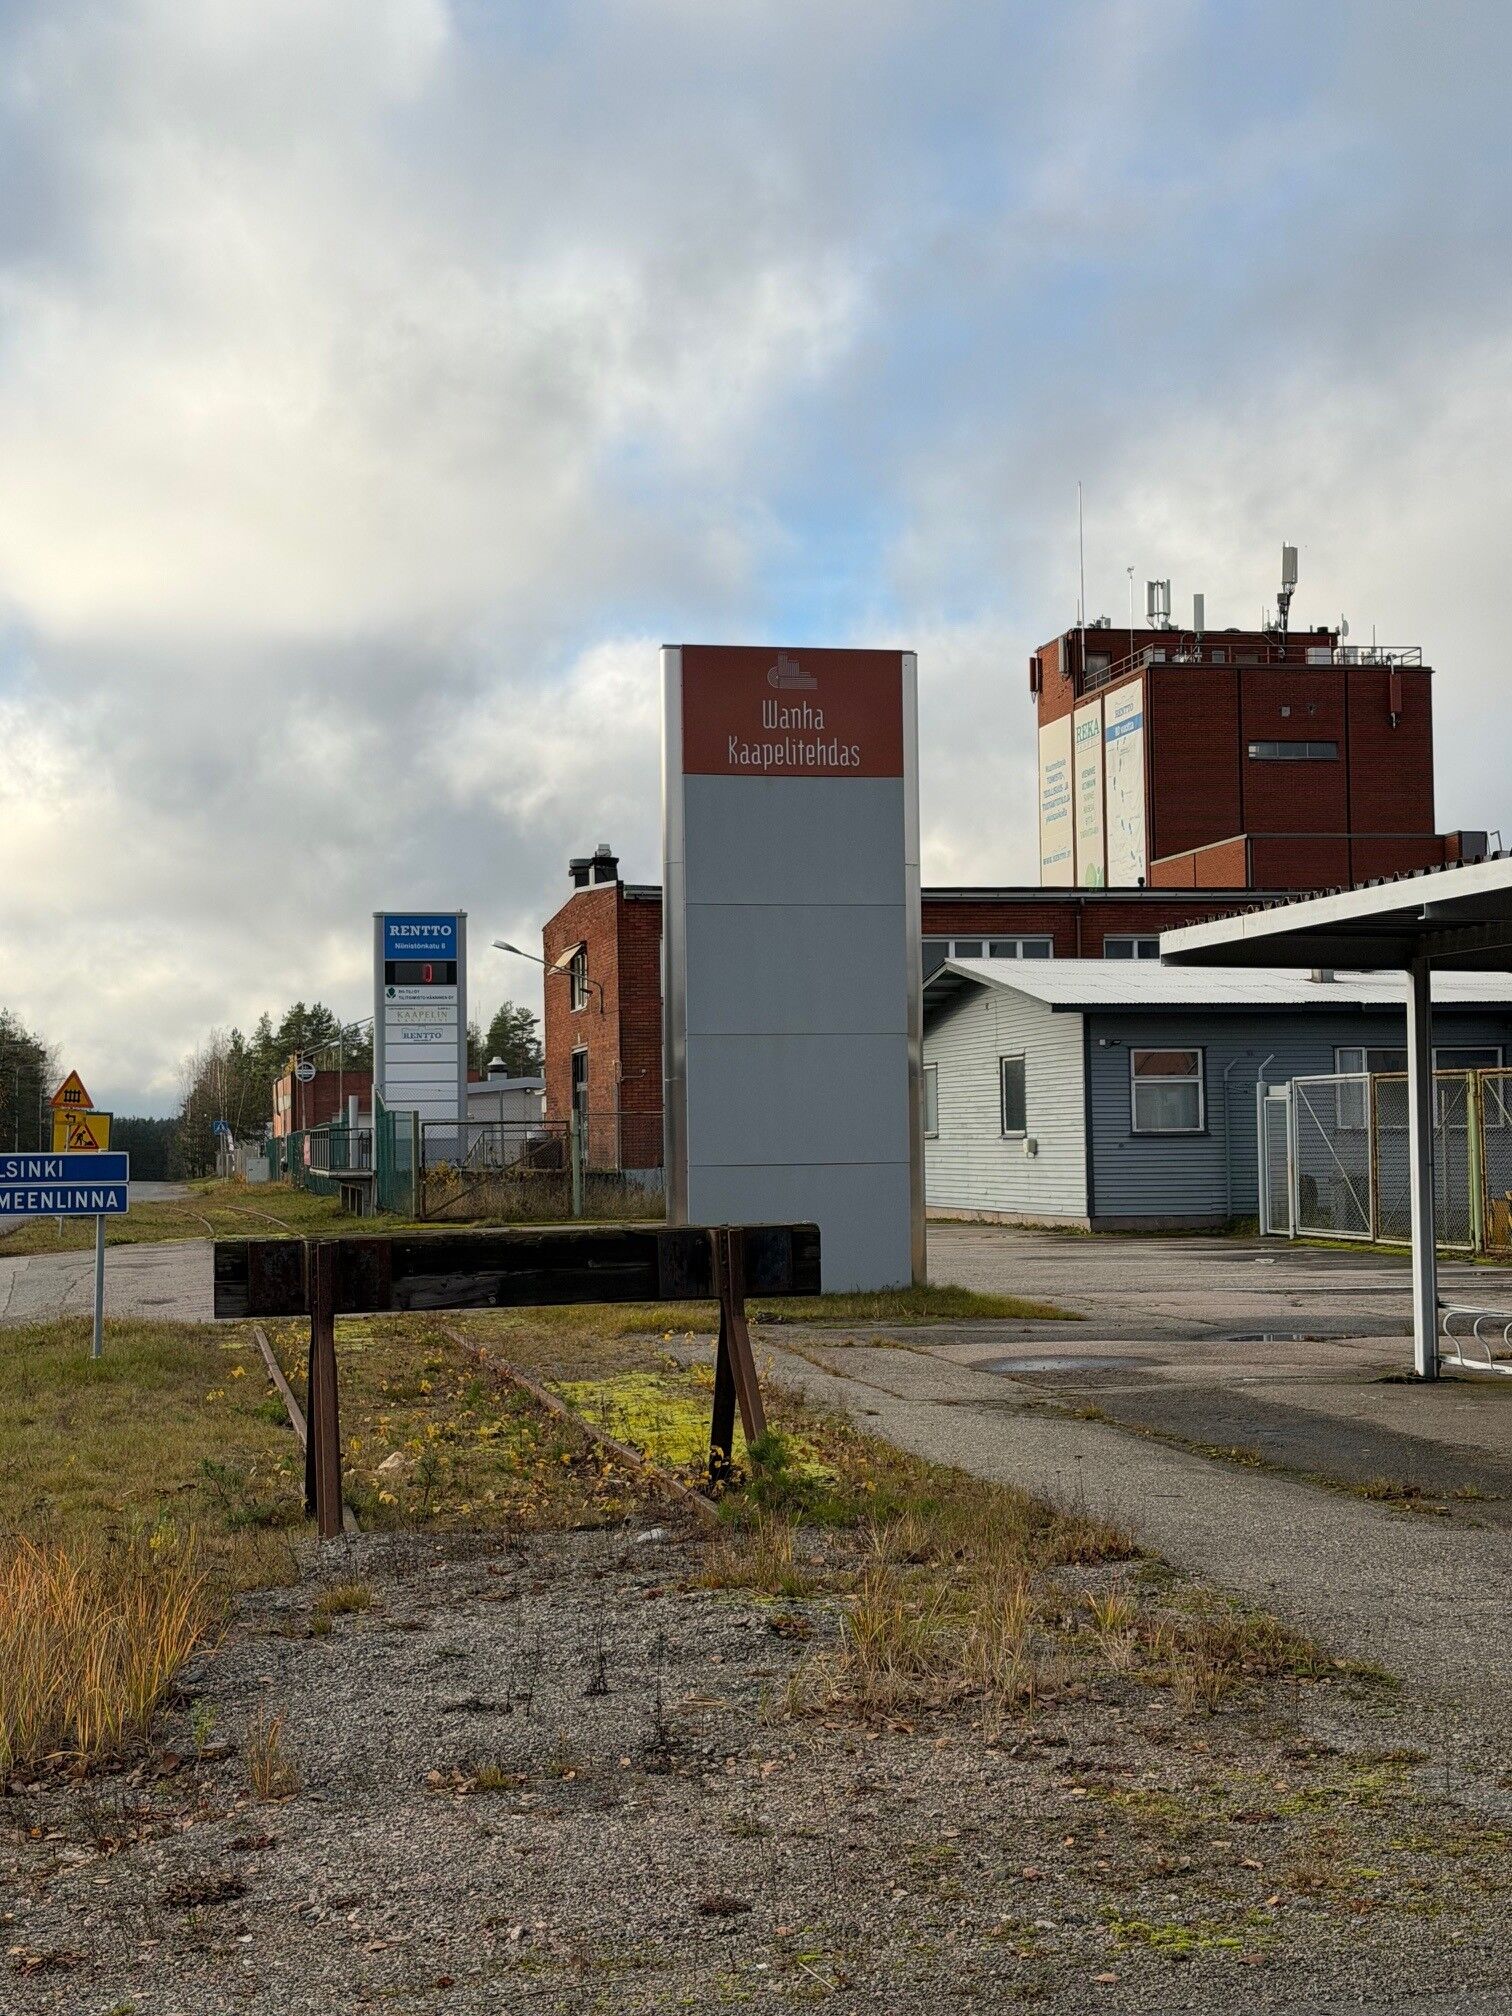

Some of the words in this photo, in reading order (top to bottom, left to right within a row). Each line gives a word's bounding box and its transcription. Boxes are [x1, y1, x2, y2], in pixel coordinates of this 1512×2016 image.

[762, 699, 825, 730] Wanha
[1076, 718, 1100, 743] REKA
[728, 735, 860, 770] Kaapelitehdas
[389, 925, 452, 936] RENTTO
[397, 1011, 448, 1019] KAAPELIN
